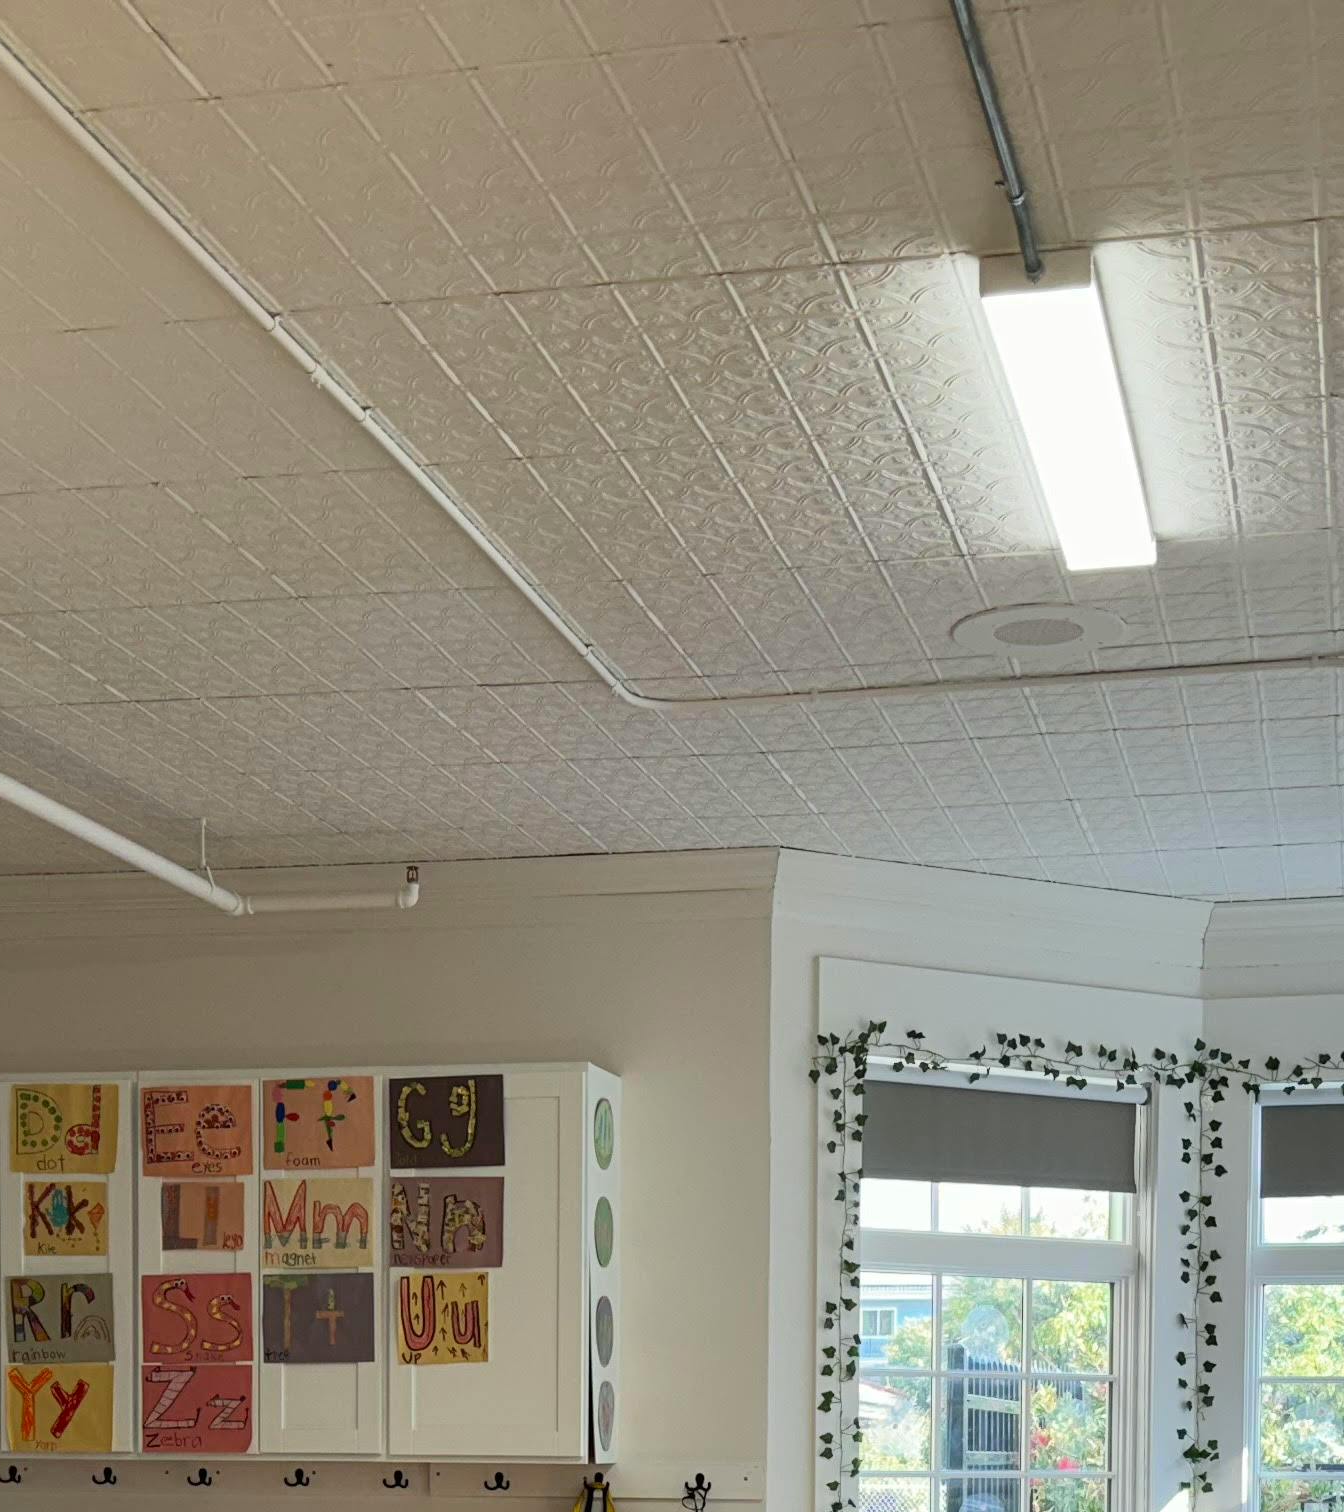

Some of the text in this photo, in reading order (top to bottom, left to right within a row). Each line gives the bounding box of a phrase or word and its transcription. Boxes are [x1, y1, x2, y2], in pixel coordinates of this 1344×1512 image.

[36, 1156, 65, 1172] dot
[191, 1160, 223, 1175] eyes
[285, 1154, 322, 1168] foam
[264, 1252, 317, 1267] magnet
[9, 1347, 67, 1363] rainbow
[145, 1432, 203, 1449] Zebra
